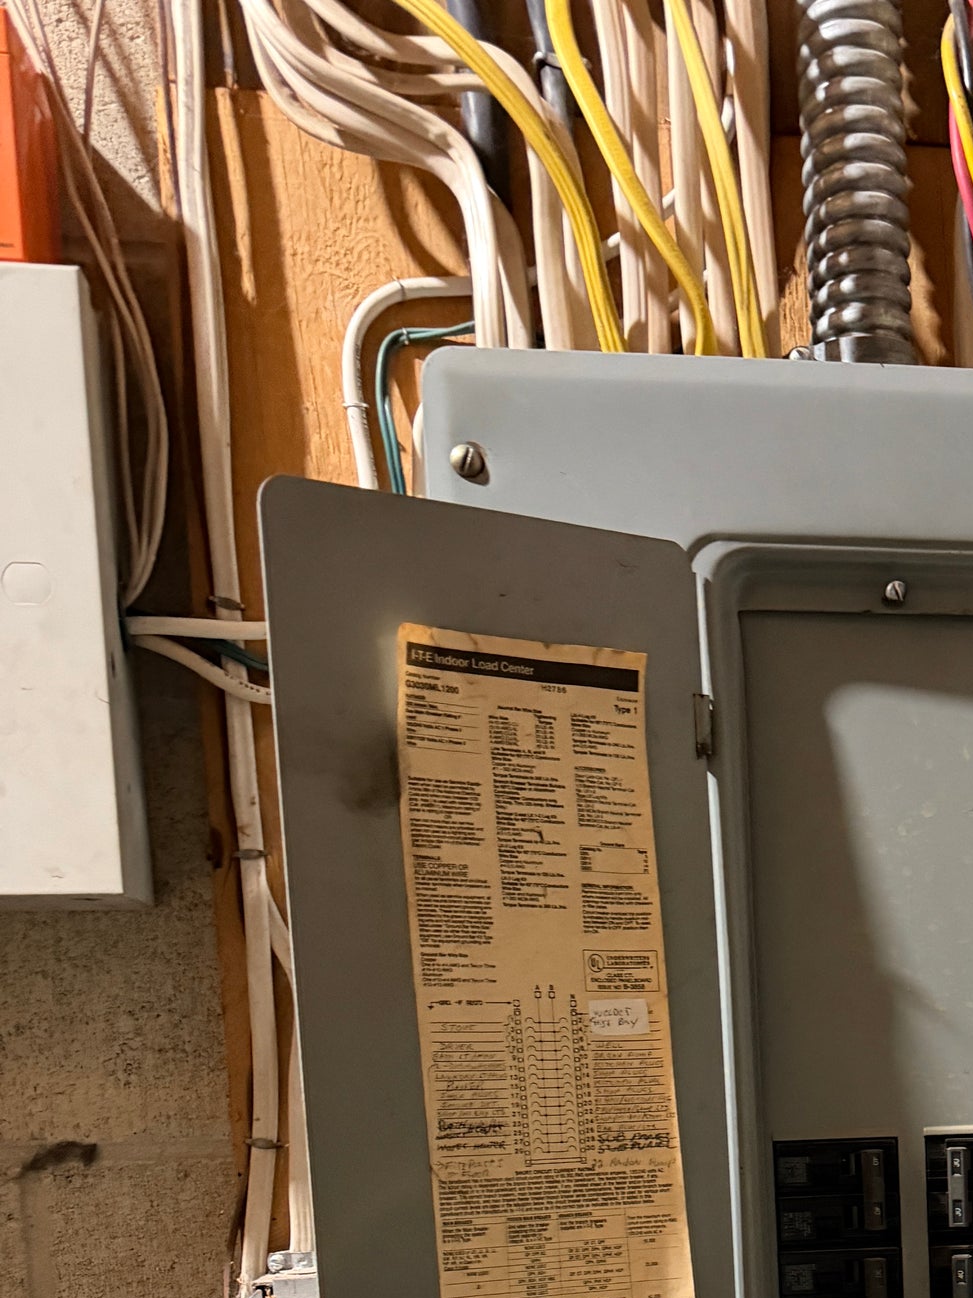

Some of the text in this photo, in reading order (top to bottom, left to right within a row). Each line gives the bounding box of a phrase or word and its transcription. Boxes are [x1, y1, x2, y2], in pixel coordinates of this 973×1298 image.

[435, 653, 469, 667] Indoor
[472, 658, 498, 671] Load
[501, 661, 534, 675] Center
[613, 704, 630, 714] Type
[428, 862, 458, 870] COPPER
